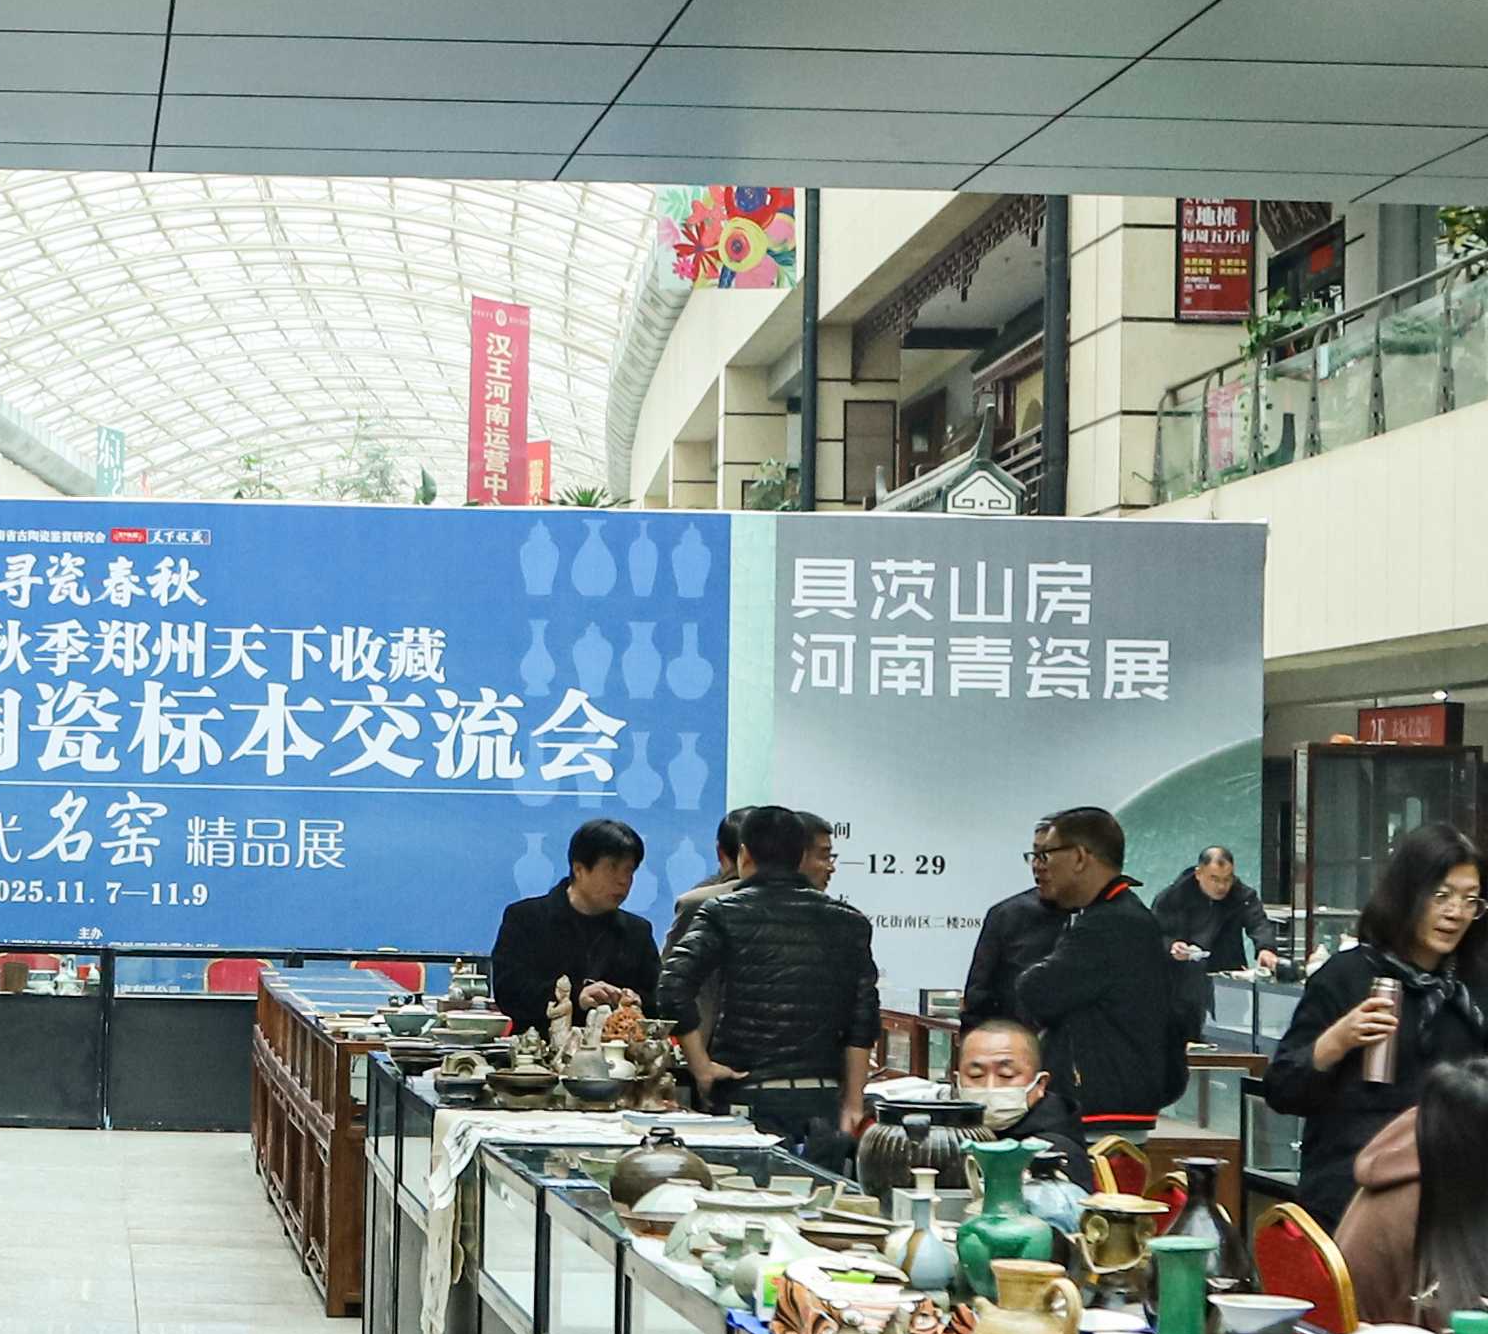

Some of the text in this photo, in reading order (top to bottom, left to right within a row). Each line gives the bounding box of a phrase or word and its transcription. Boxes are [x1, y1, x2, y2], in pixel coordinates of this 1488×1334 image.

[790, 558, 1092, 625] 具茨山房
[789, 633, 1171, 702] 河南青瓷展
